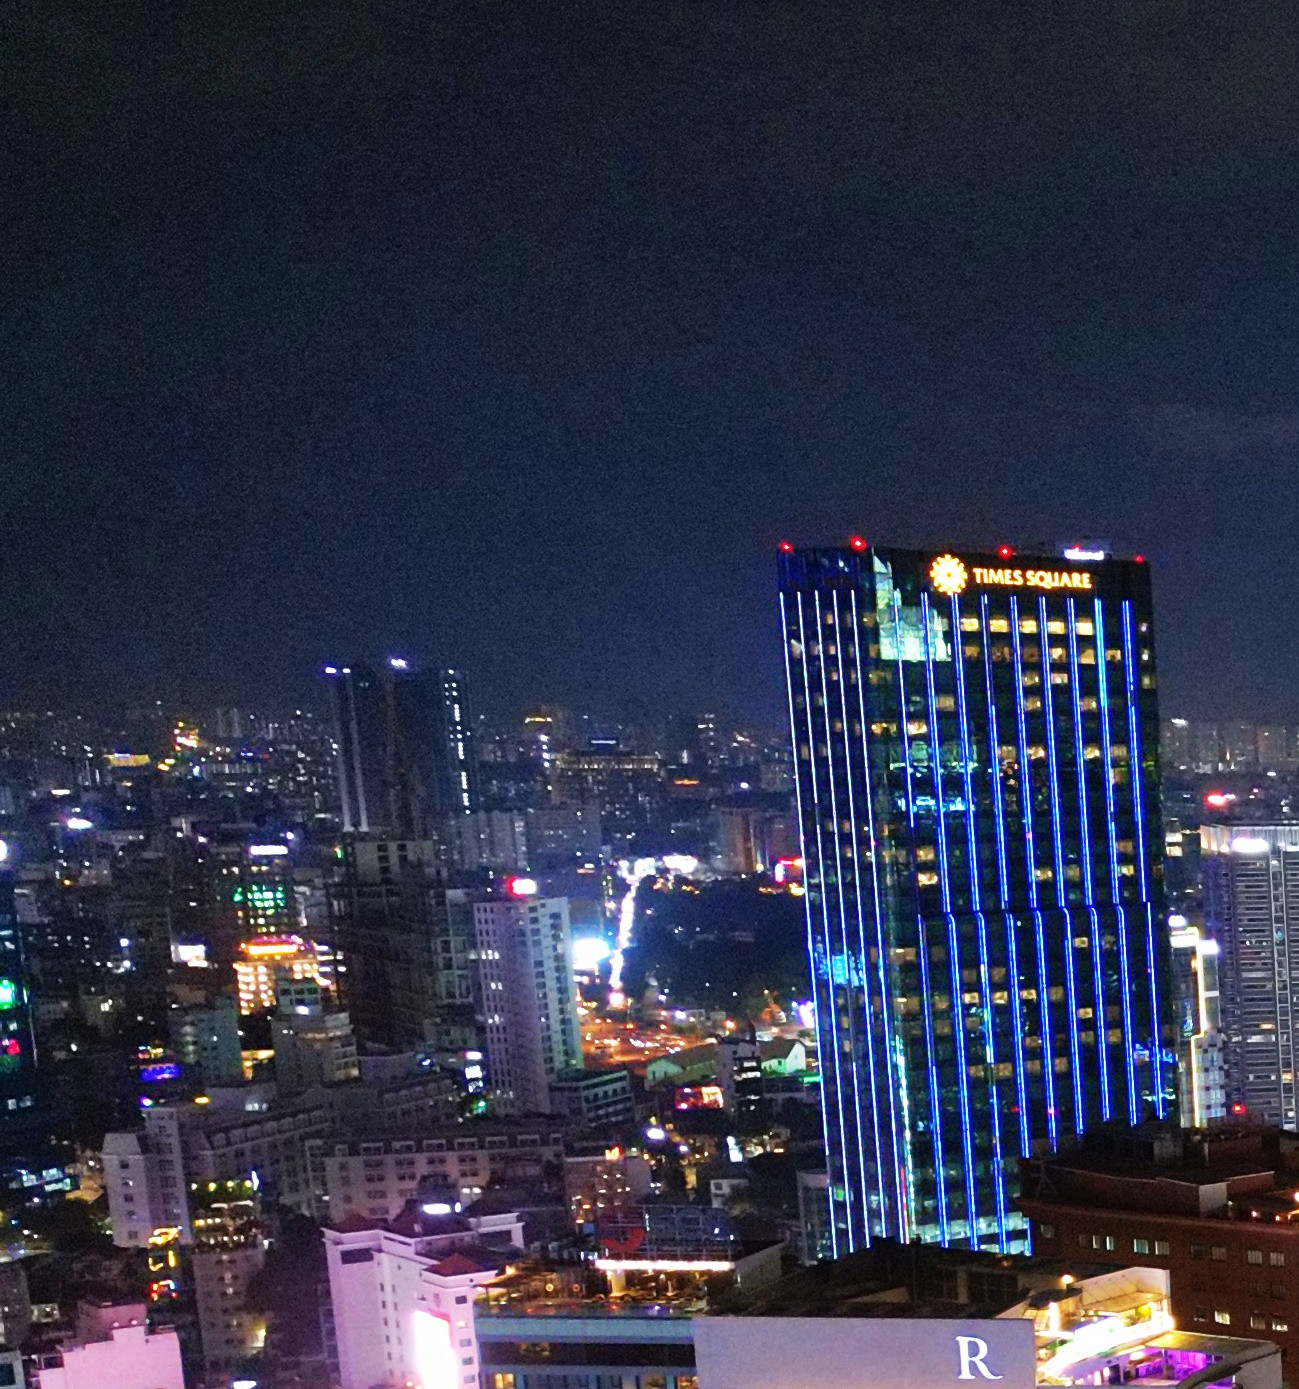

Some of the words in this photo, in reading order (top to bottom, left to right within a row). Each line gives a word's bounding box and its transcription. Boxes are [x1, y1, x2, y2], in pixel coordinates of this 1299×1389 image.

[972, 567, 1024, 586] TIMES
[1025, 570, 1092, 590] SQUARE
[955, 1335, 1003, 1380] R
